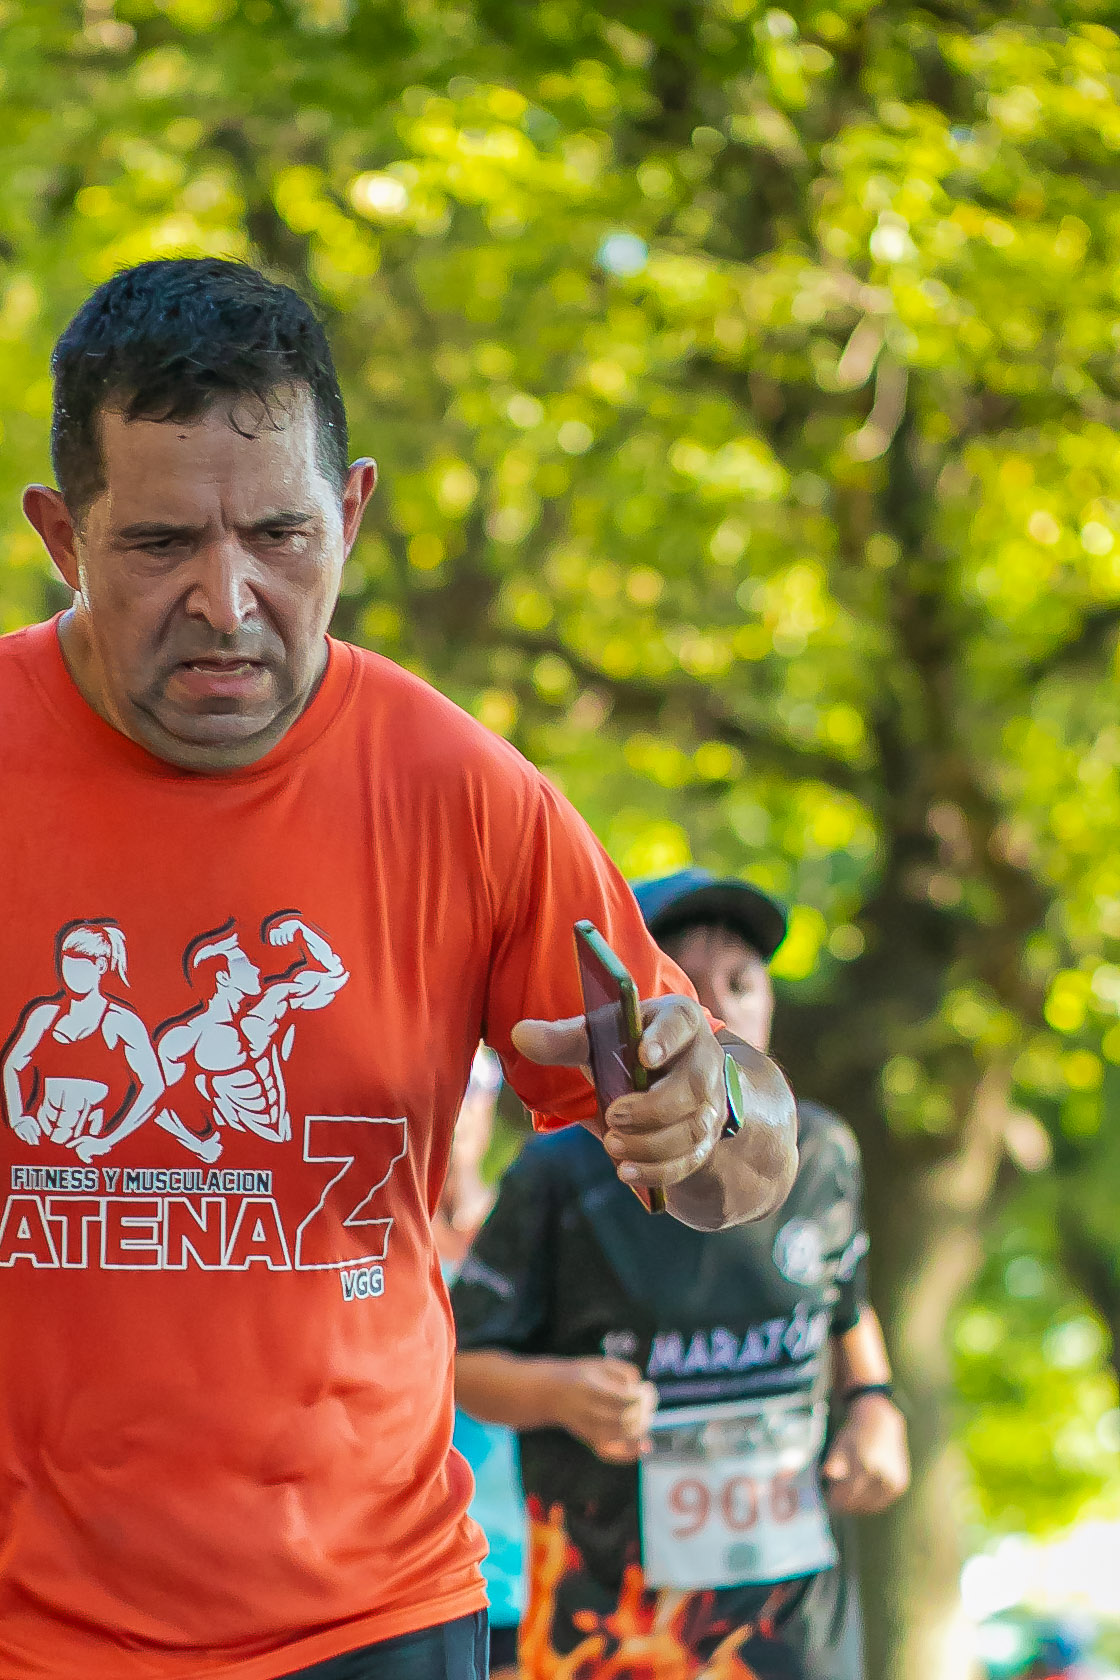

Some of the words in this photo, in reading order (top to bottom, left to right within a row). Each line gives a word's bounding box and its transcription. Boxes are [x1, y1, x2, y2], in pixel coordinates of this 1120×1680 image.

[11, 1166, 98, 1190] FITNESS
[101, 1168, 120, 1191] Y
[123, 1169, 272, 1194] MUSCULACION
[341, 1266, 384, 1301] VGG
